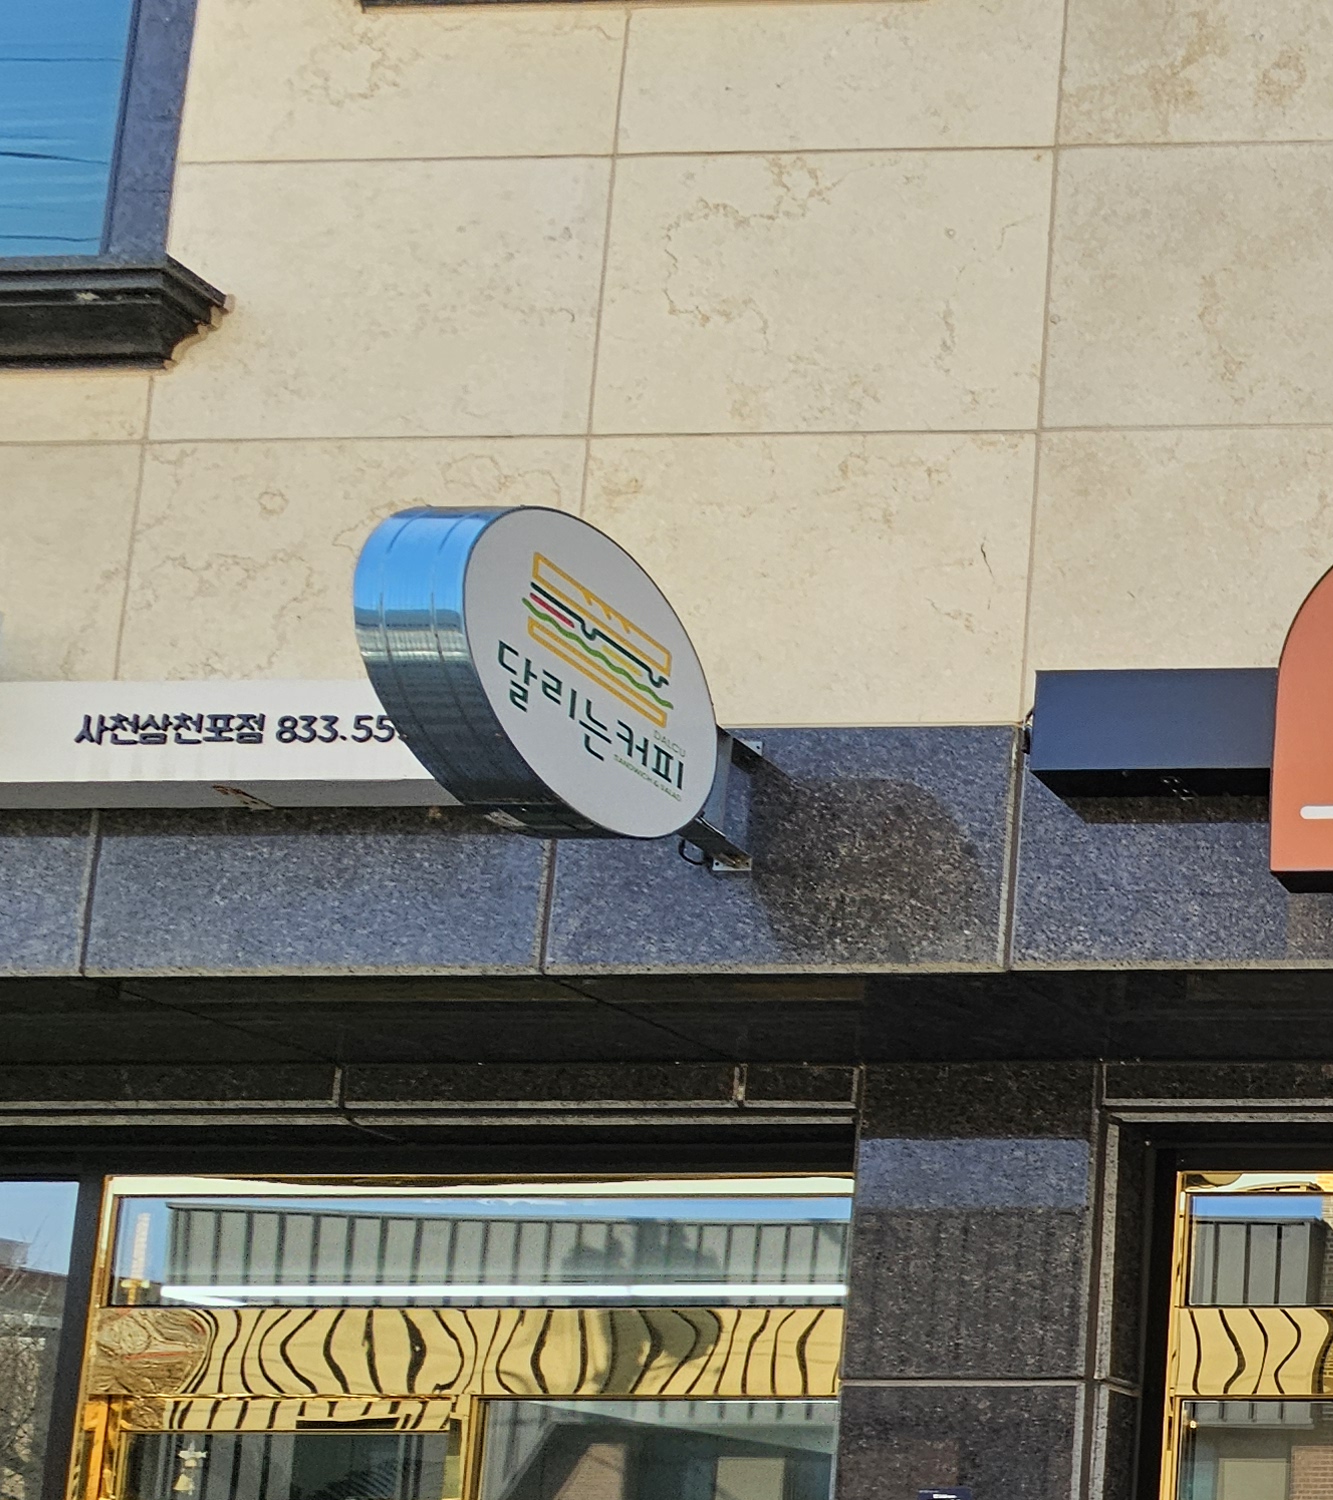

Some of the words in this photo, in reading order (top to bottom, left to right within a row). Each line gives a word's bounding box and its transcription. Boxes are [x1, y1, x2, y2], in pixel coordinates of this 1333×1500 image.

[74, 712, 266, 745] 사천삼천포점
[275, 714, 400, 743] 833.55
[497, 638, 684, 791] 달리는커피
[653, 730, 686, 758] DALCU
